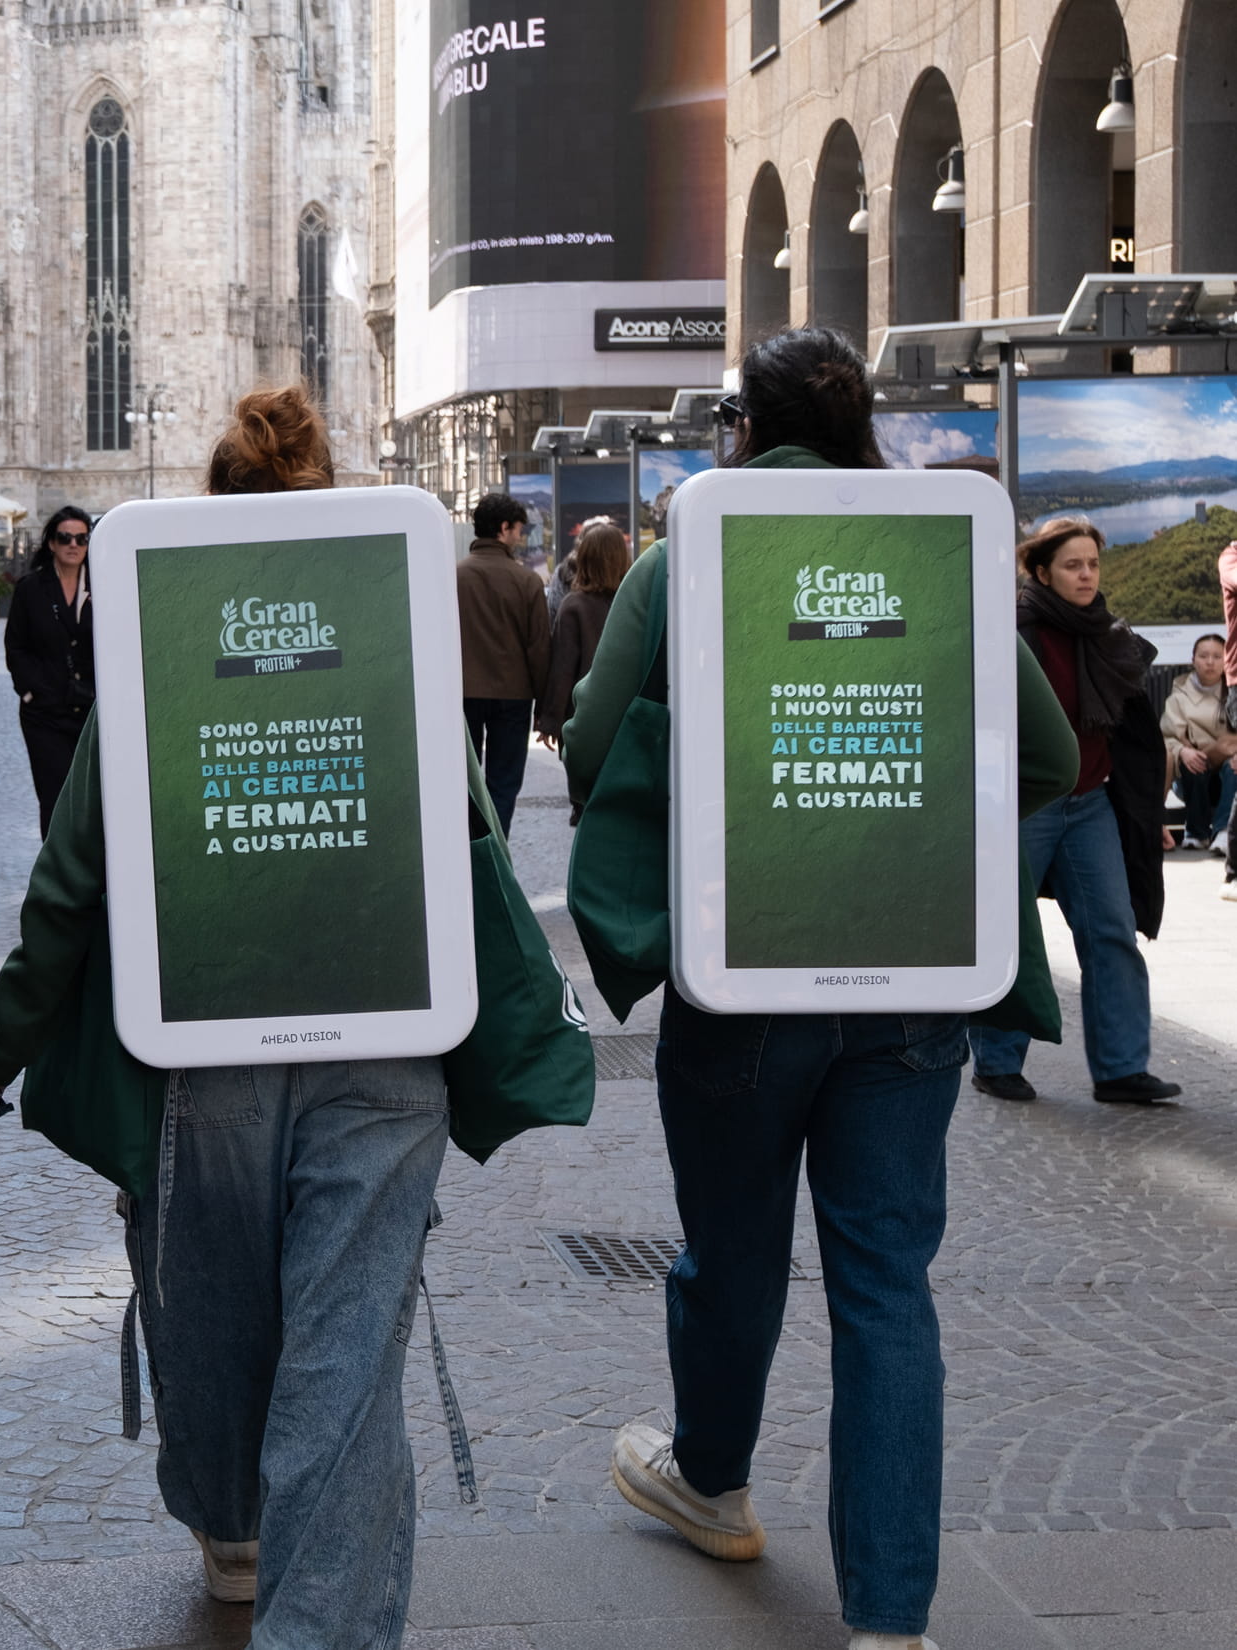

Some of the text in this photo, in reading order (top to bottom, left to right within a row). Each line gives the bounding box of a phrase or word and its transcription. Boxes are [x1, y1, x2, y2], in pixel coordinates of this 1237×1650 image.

[453, 61, 488, 97] BLU
[519, 235, 544, 245] misto
[545, 233, 585, 245] 198-207
[609, 317, 670, 336] Acone
[815, 565, 885, 593] Gran
[242, 597, 317, 626] Gran
[799, 589, 902, 617] Cereale
[225, 621, 336, 652] Cereale
[825, 623, 869, 639] PROTEIN+
[254, 655, 302, 674] PROTEIN+
[771, 684, 922, 697] SONO ARRIVATI
[771, 701, 923, 716] I NUOVI GUSTI
[199, 717, 363, 739] SONO ARRIVATI
[771, 721, 923, 734] DELLE BARRETTE
[200, 735, 364, 758] I NUOVI GUSTI
[771, 736, 923, 755] AI CEREALI
[201, 757, 365, 777] DELLE BARRETTE
[772, 762, 923, 784] FERMATI
[203, 773, 365, 799] AI CEREALI
[772, 791, 923, 808] A GUSTARLE
[204, 798, 367, 830] FERMATI
[206, 830, 368, 855] A GUSTARLE
[815, 975, 890, 985] AHEAD VISION
[261, 1031, 341, 1045] AHEAD VISION
